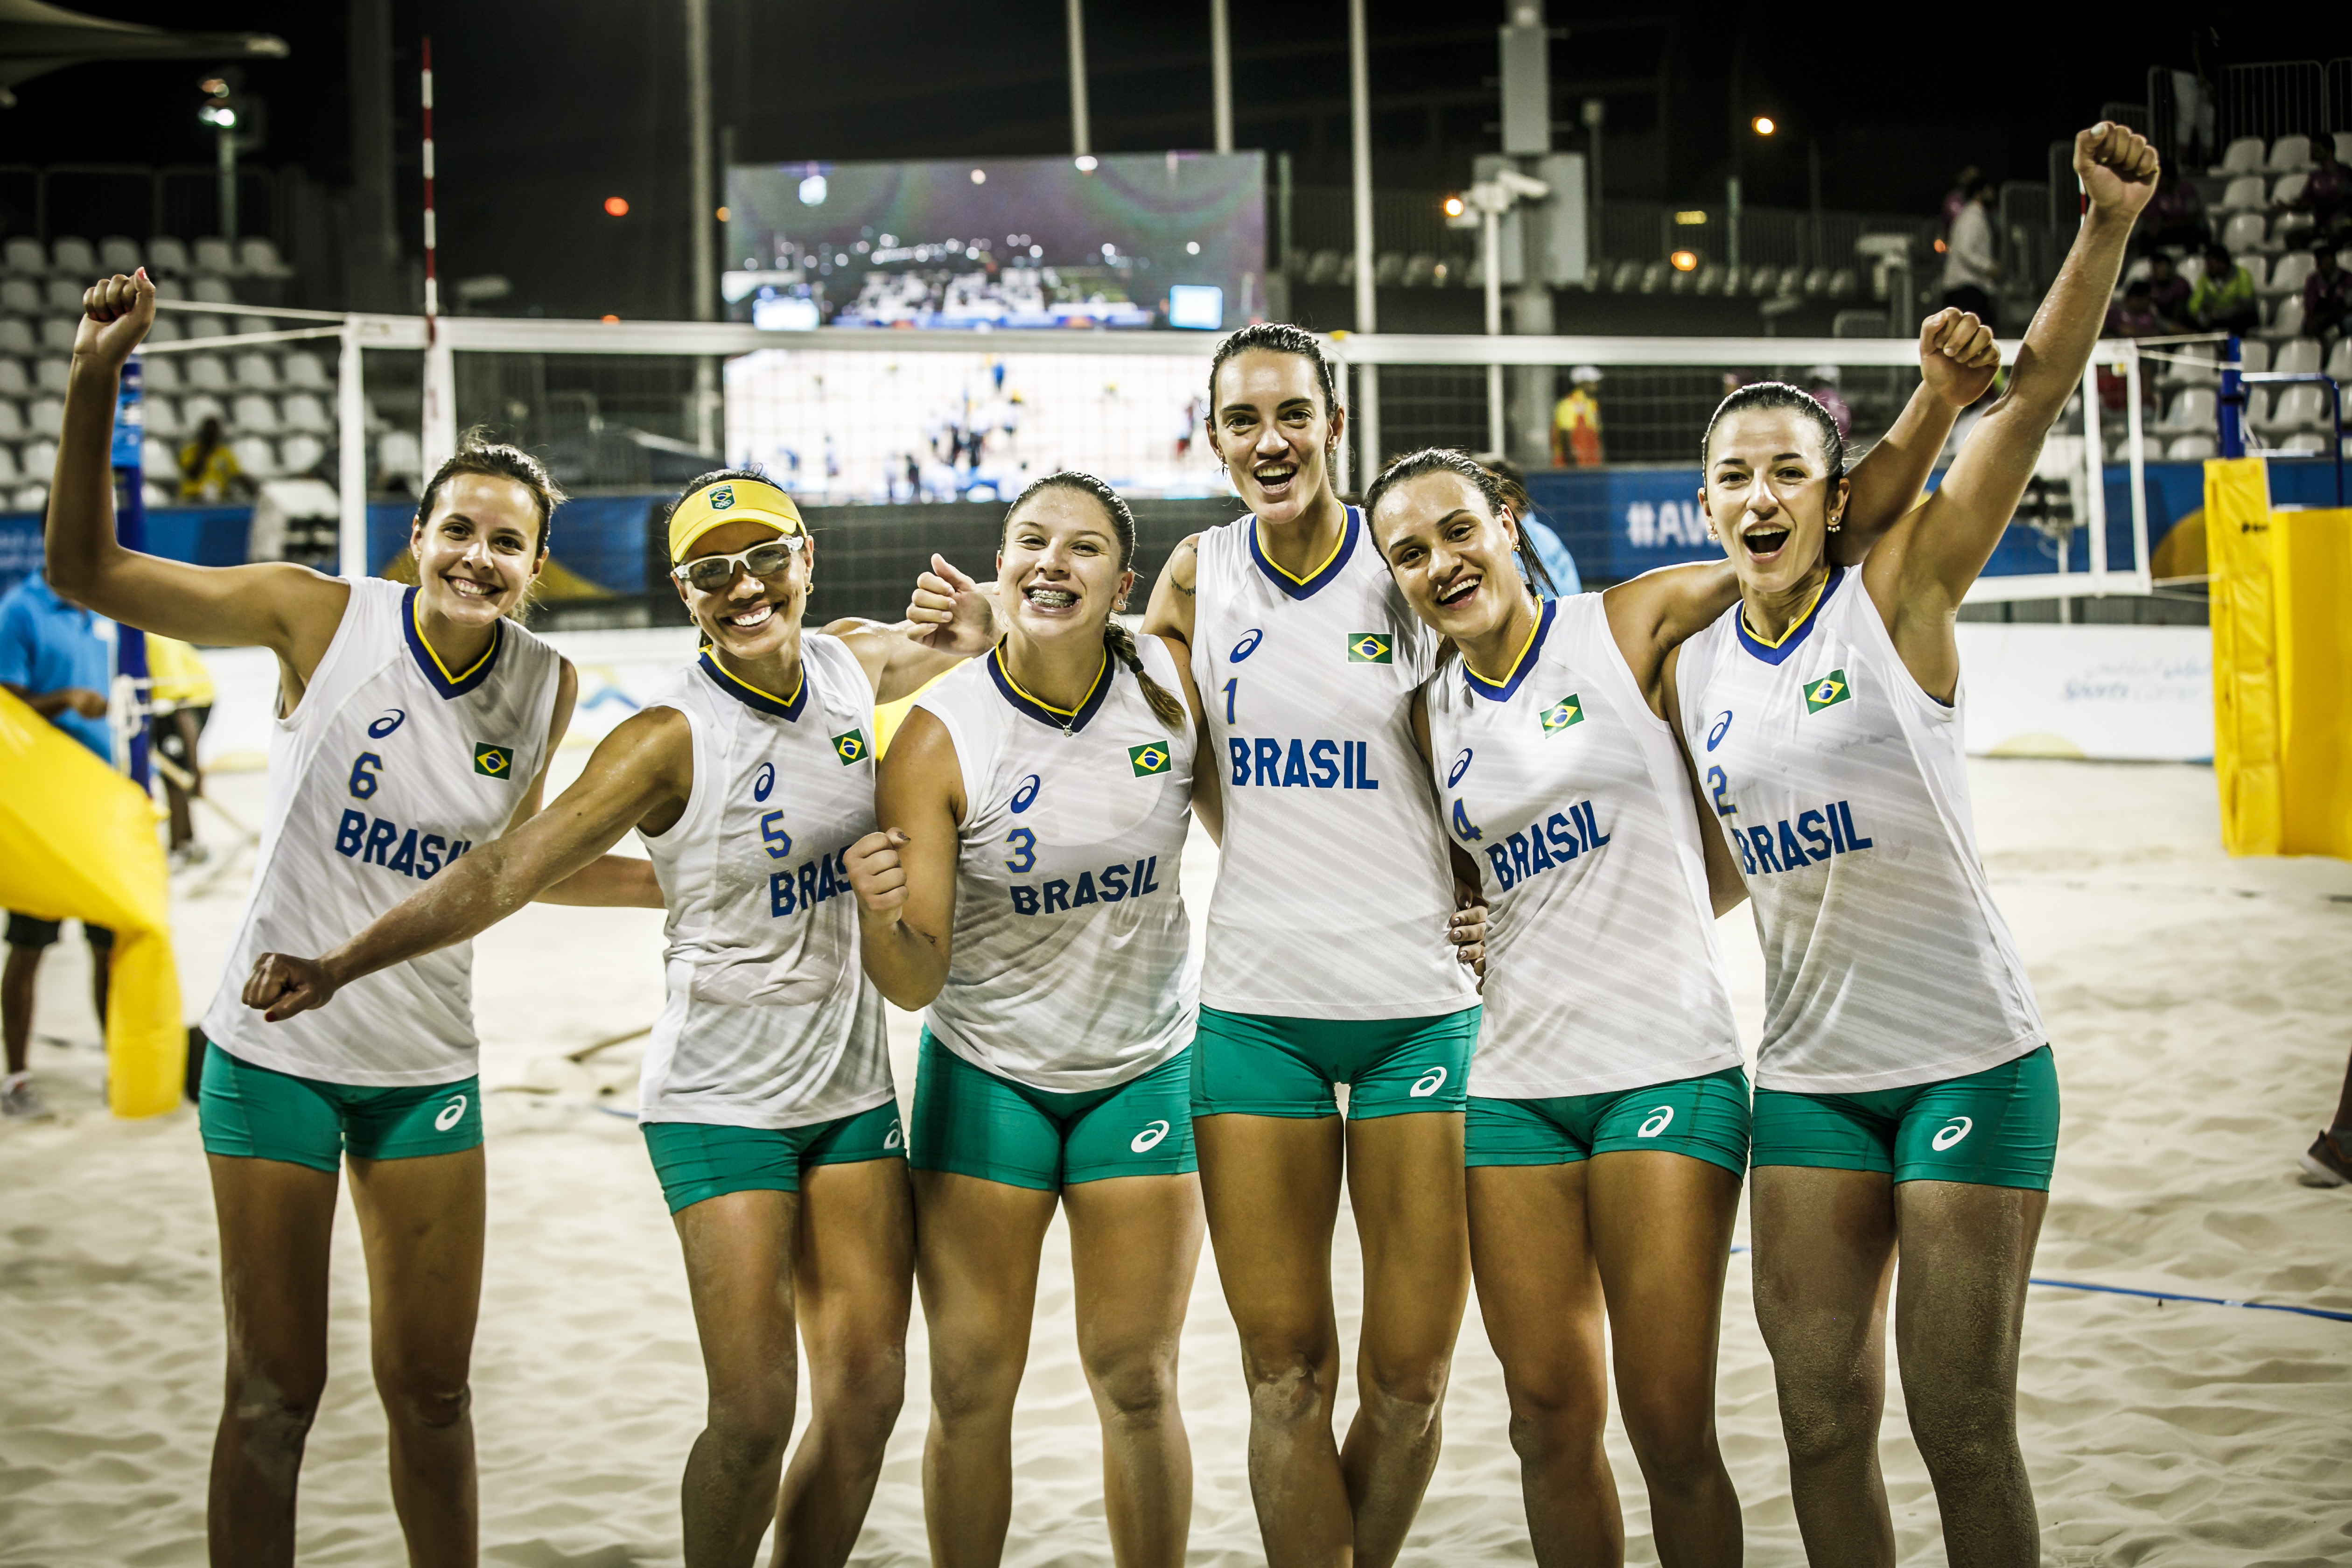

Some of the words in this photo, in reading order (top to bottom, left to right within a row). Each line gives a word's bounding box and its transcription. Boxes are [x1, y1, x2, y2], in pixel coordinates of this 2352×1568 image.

[1221, 677, 1239, 725] 1
[348, 751, 384, 801] 6
[1228, 737, 1379, 790] BRASIL
[1707, 765, 1738, 818] 2
[335, 808, 472, 880] BRASI
[759, 809, 792, 861] 5
[1453, 797, 1484, 842] 4
[1484, 800, 1610, 892] BRASIL
[1730, 800, 1873, 875] BRASIL
[1003, 827, 1037, 875] 3
[1009, 855, 1159, 916] BRASIL
